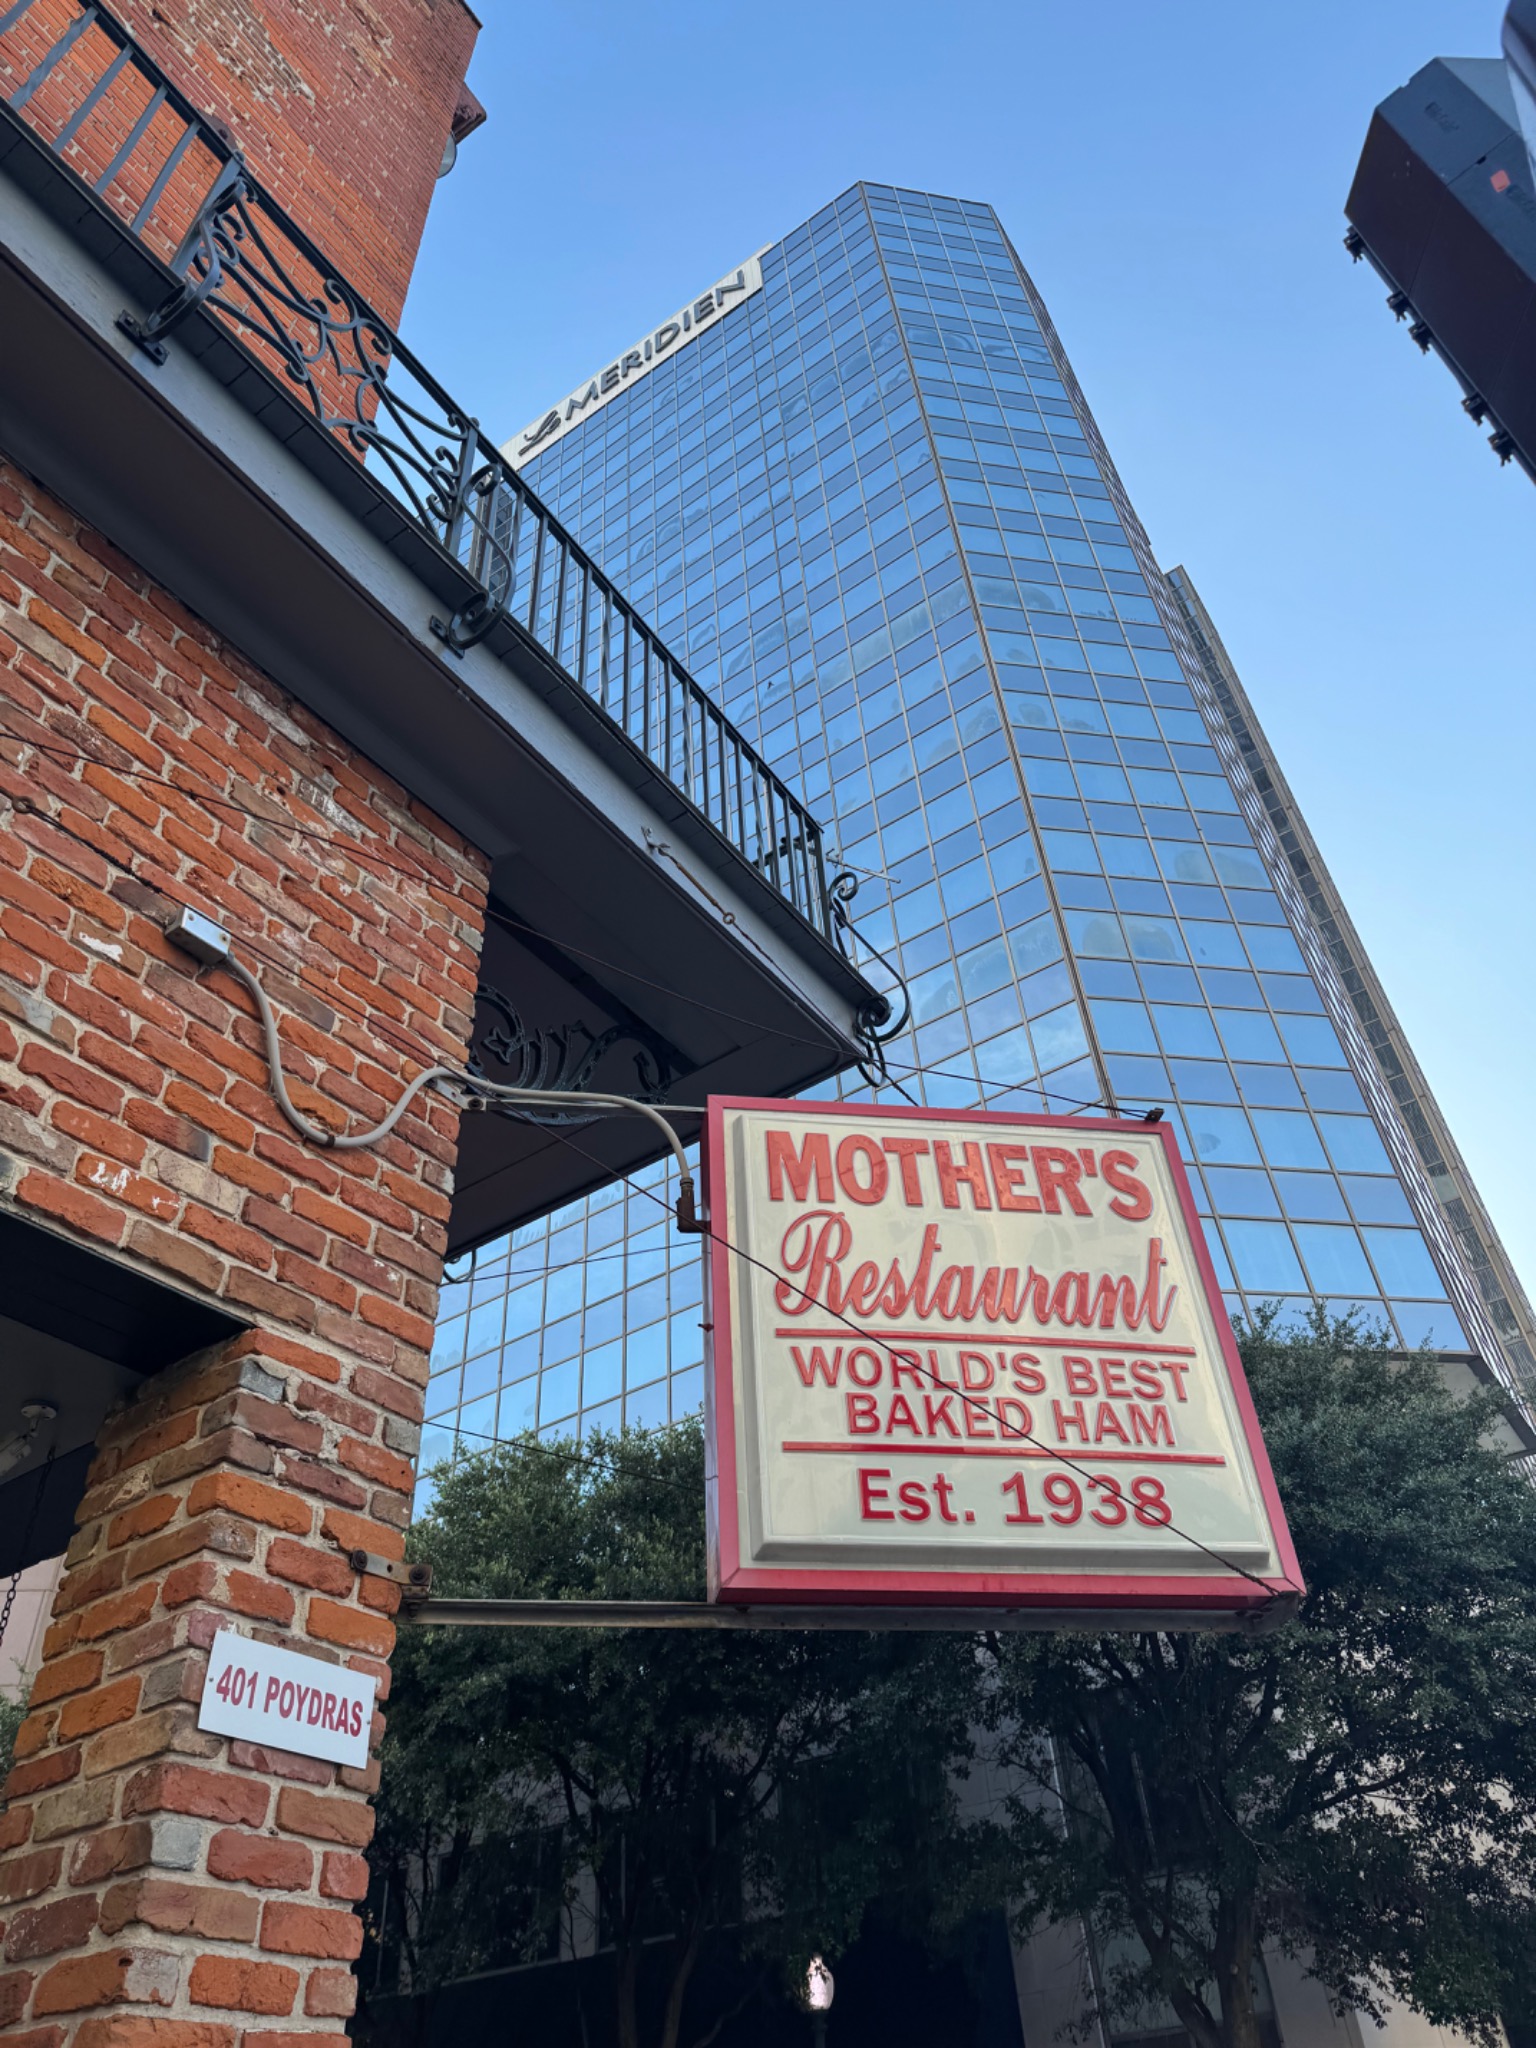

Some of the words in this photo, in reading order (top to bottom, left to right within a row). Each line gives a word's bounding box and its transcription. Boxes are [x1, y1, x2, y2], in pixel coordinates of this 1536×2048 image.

[565, 269, 746, 421] MERIDIEN
[766, 1130, 1153, 1221] MOTHER'S
[775, 1210, 1177, 1332] Restaurant
[791, 1346, 1046, 1394] WORLD'S
[1062, 1356, 1189, 1401] BEST
[846, 1392, 1032, 1439] BAKED
[1053, 1401, 1175, 1447] HAM
[858, 1467, 975, 1524] Est.
[1003, 1471, 1172, 1528] 1938
[216, 1664, 259, 1709] 401
[263, 1676, 363, 1737] POYDRAS
